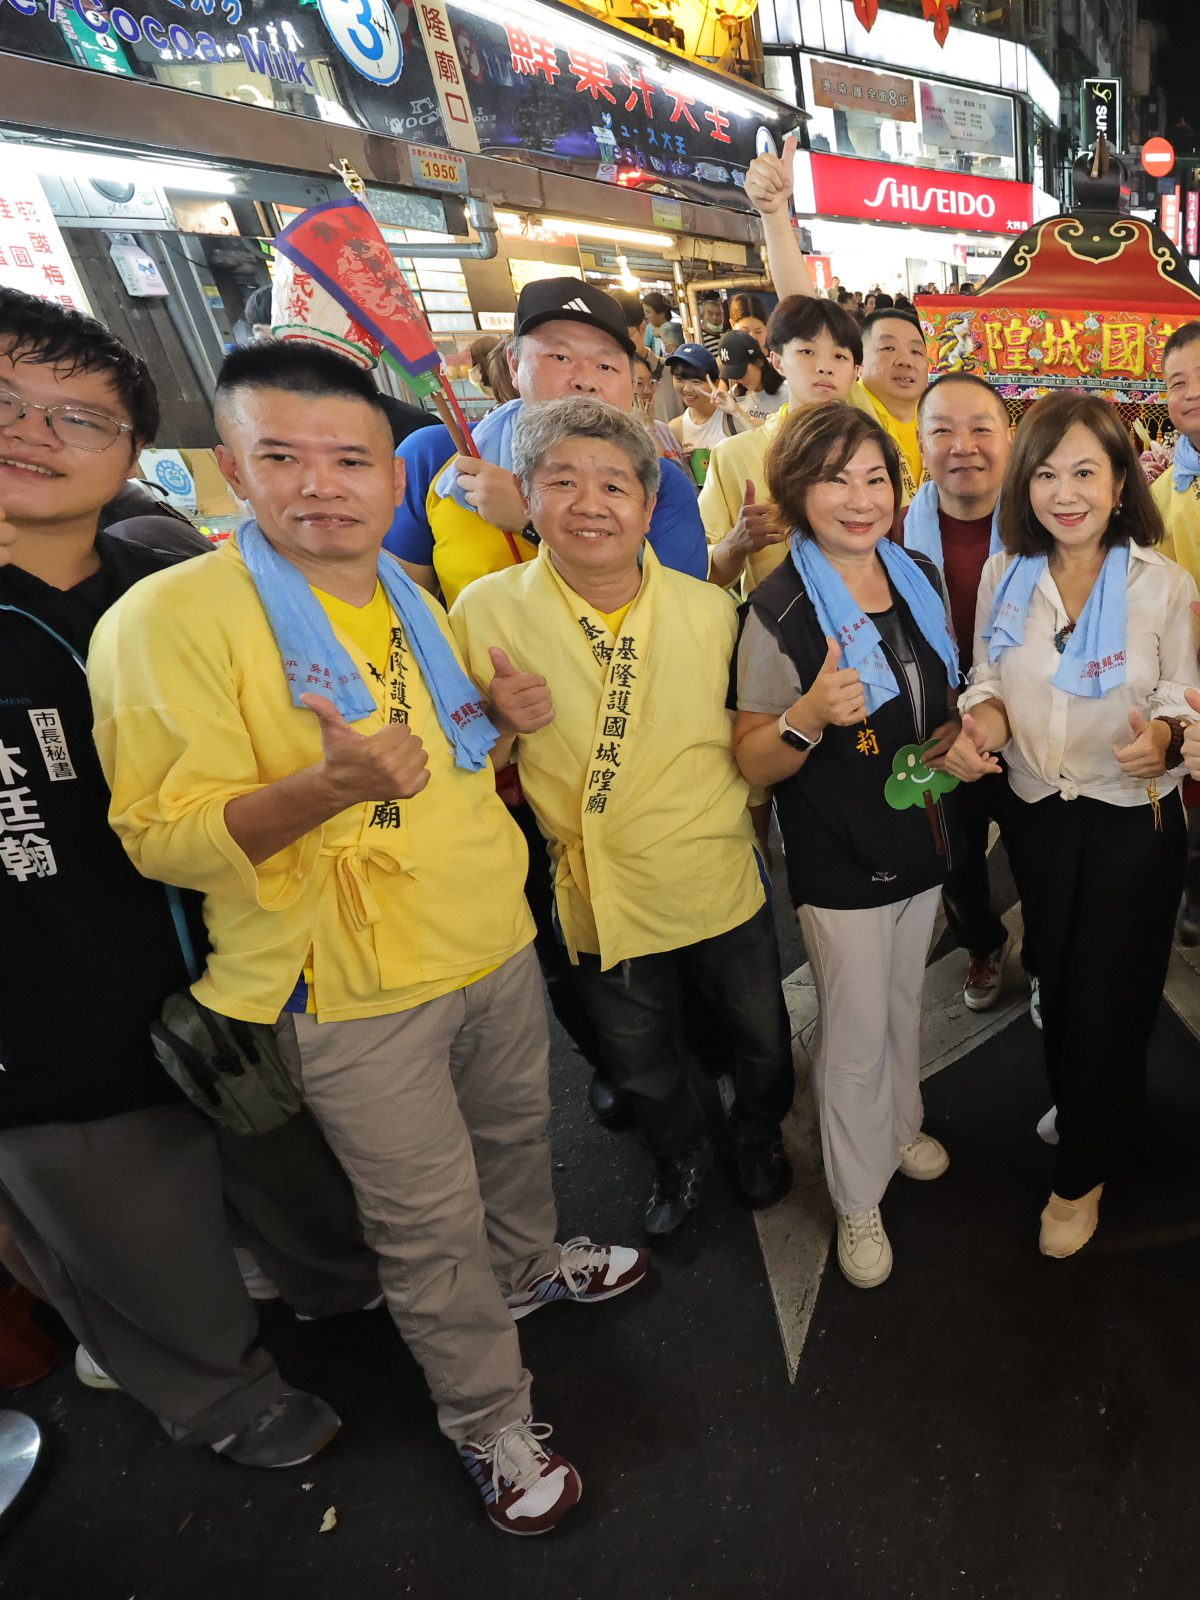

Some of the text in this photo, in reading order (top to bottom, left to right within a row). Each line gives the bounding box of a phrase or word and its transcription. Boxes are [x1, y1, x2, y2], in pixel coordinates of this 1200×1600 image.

[237, 34, 314, 87] Milk
[346, 0, 384, 61] 3
[503, 20, 734, 145] 鮮果汁大王
[425, 162, 456, 181] 1950
[863, 177, 996, 219] SHISEIDO
[287, 264, 314, 323] 民安
[33, 711, 73, 778] 市長秘書
[584, 636, 640, 815] 基隆護國城隍廟
